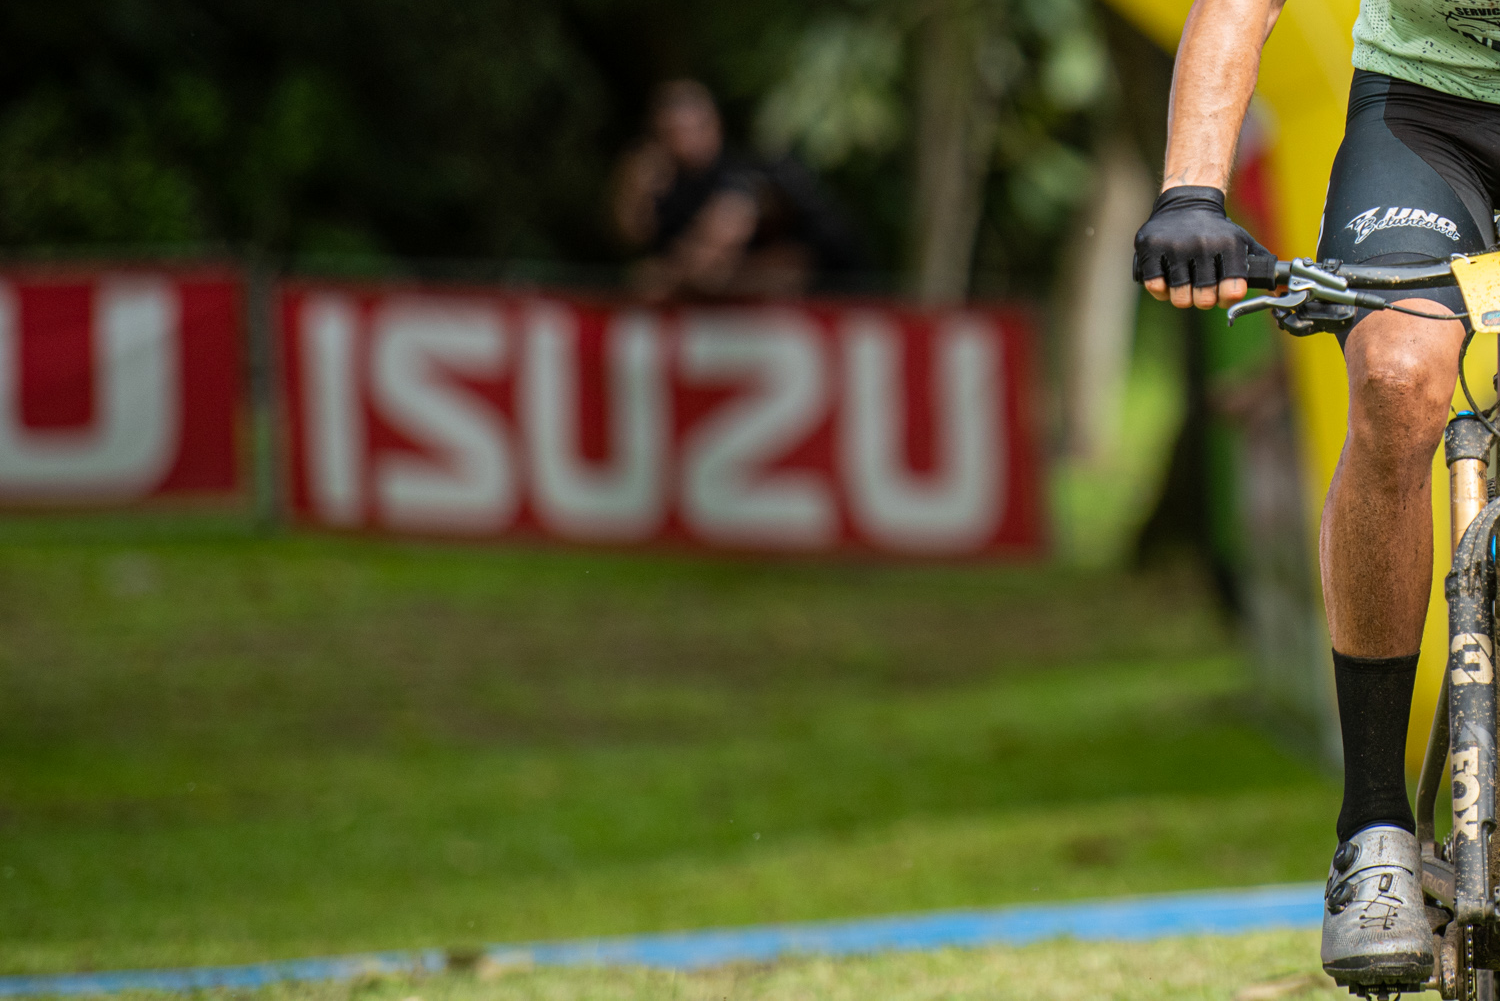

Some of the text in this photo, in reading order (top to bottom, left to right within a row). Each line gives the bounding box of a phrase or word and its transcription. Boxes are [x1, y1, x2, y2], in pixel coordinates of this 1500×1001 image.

[0, 274, 182, 497] U
[298, 289, 1005, 553] ISUZU
[1453, 746, 1481, 841] FOX
